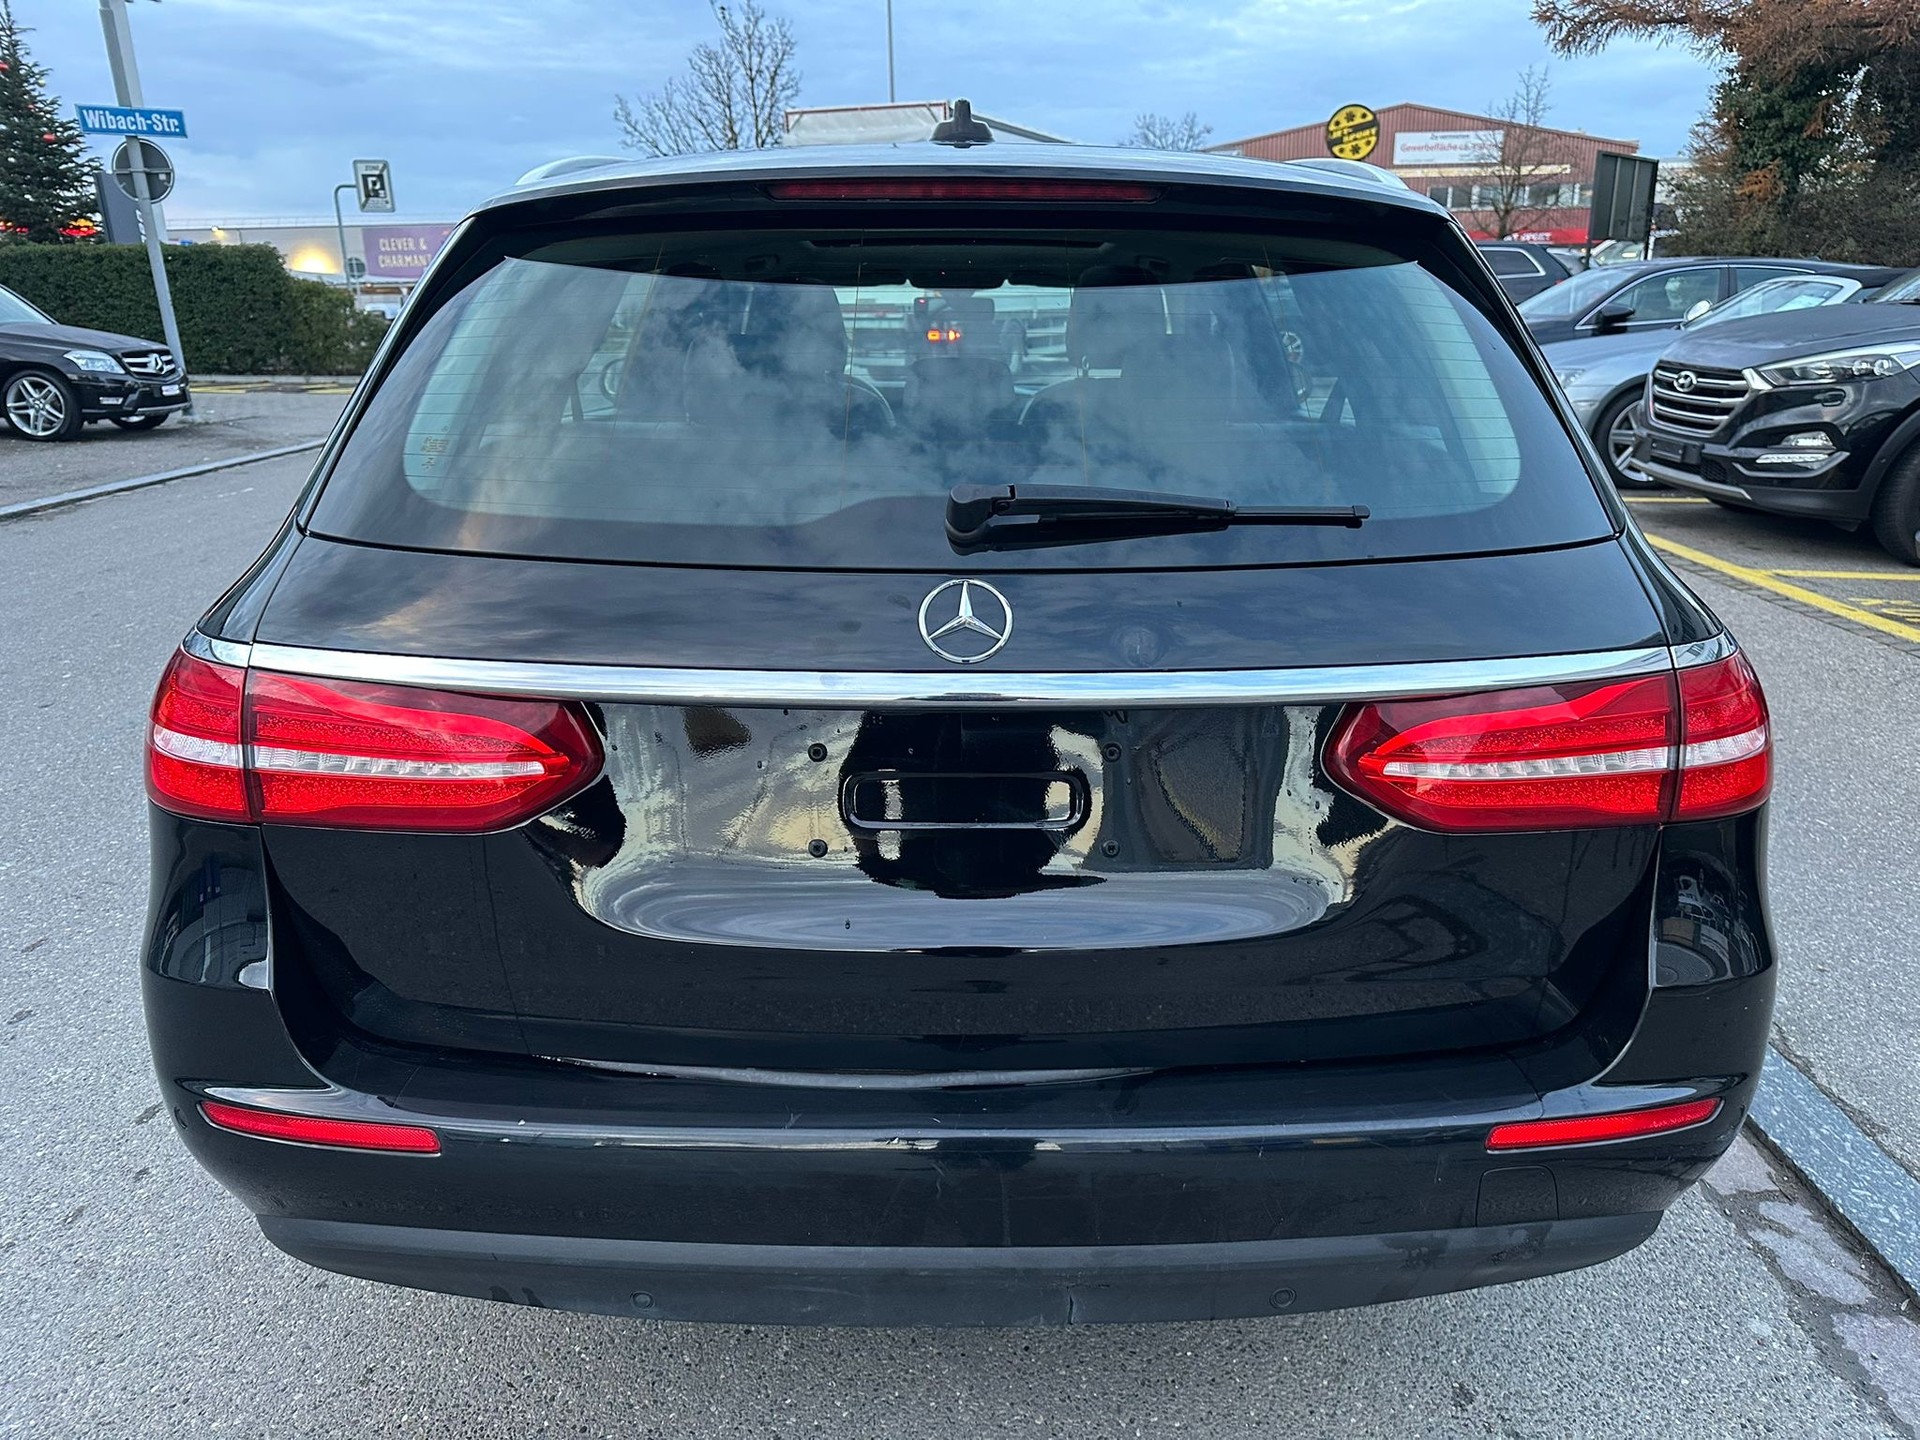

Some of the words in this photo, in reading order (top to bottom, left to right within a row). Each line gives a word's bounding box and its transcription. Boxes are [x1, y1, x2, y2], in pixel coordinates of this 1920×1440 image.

[82, 109, 180, 132] Wibach-Str.
[367, 176, 380, 196] P
[380, 238, 415, 251] CLEVER
